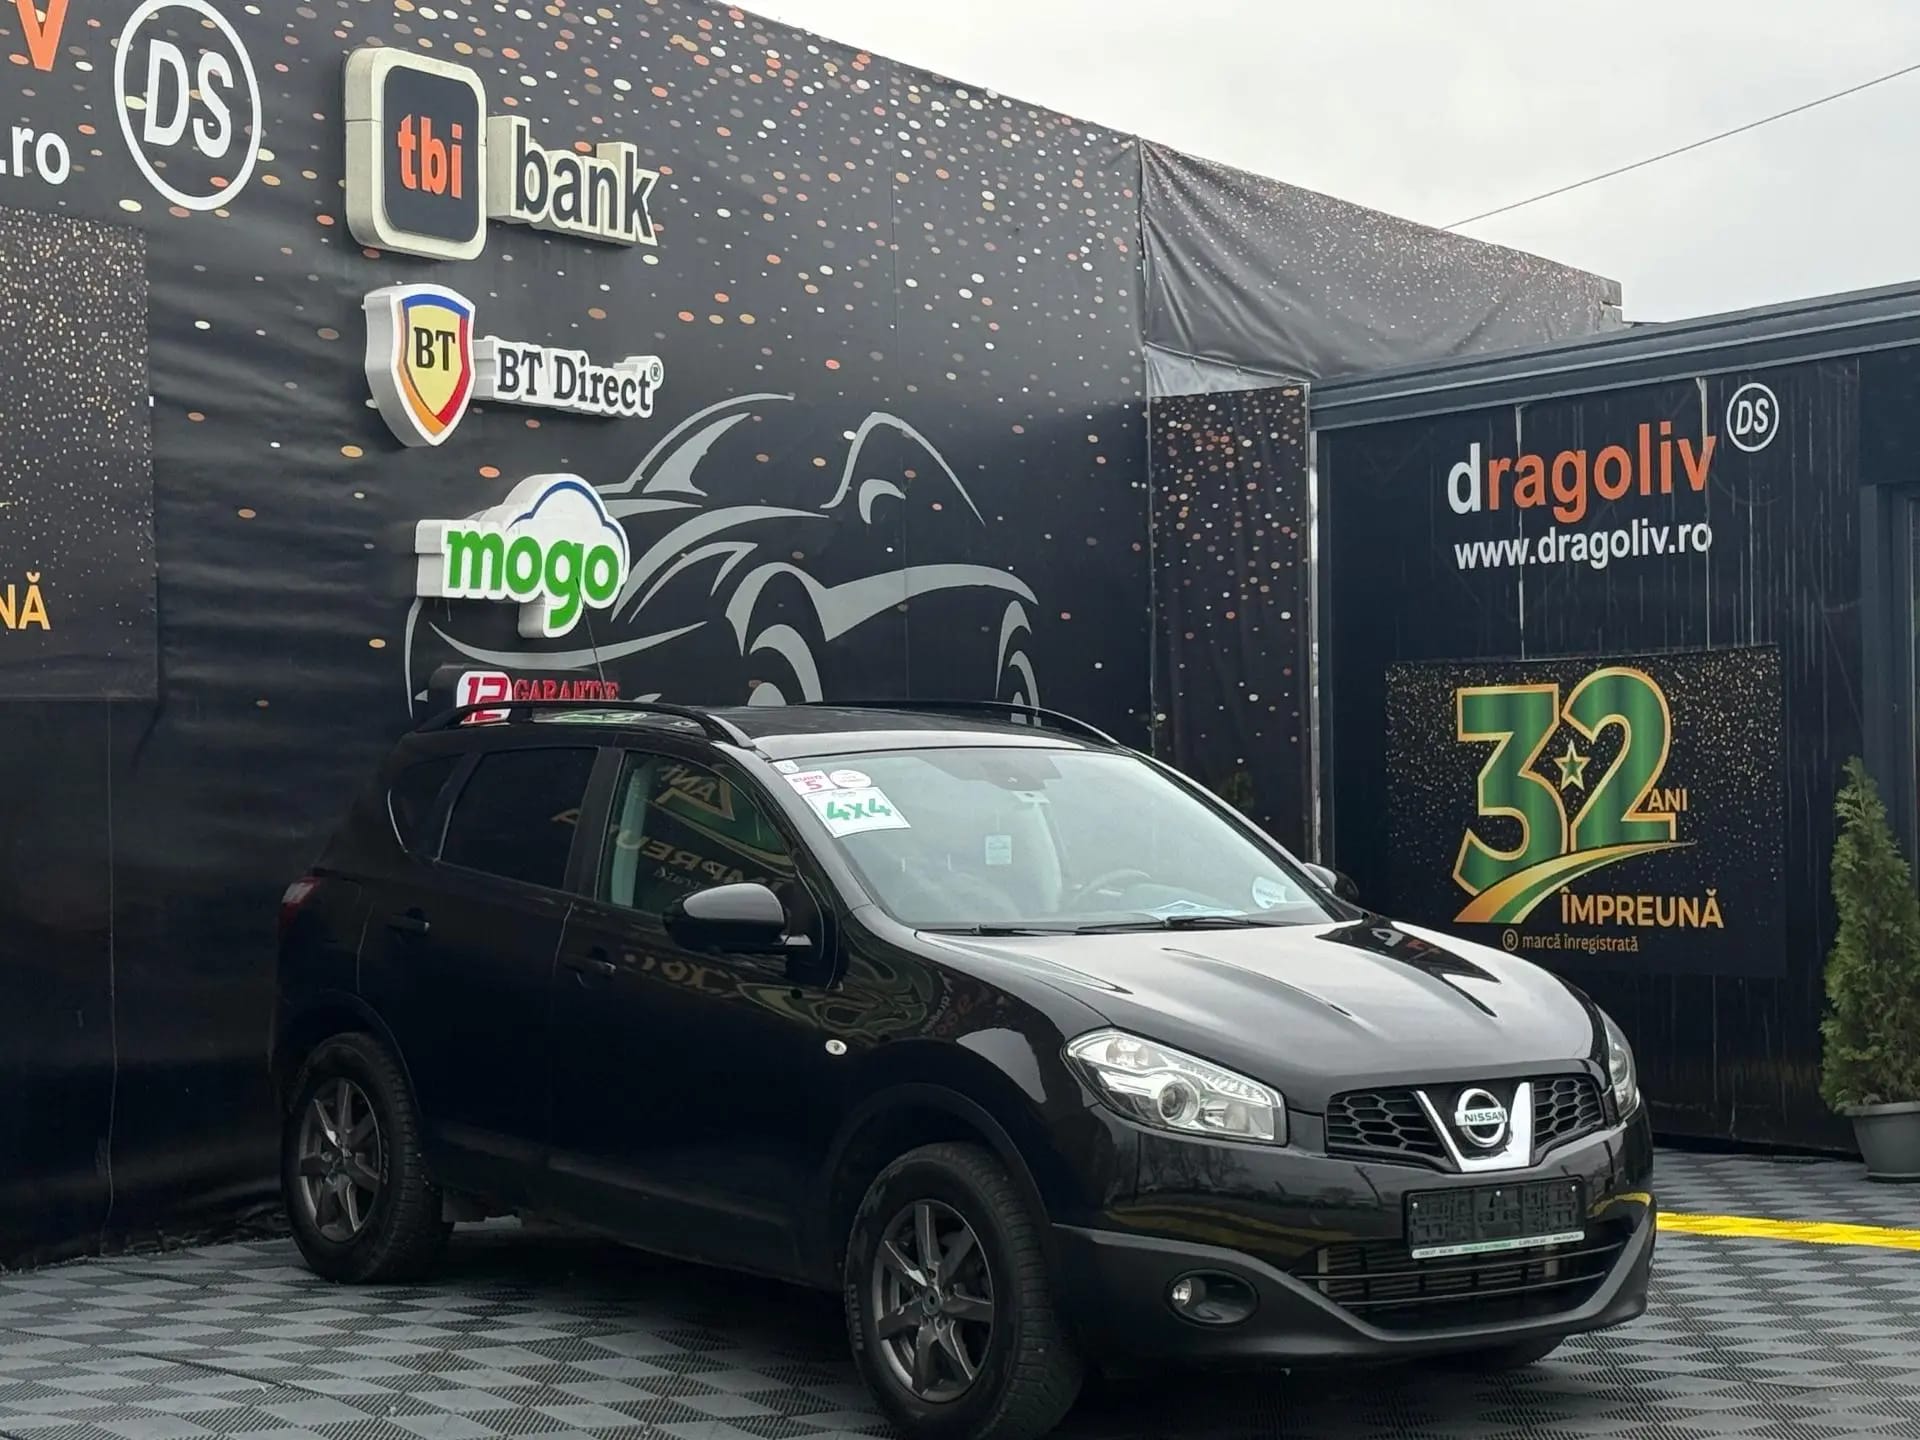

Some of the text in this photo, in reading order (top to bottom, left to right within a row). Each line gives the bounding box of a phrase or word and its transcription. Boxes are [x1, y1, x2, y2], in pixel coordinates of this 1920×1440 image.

[144, 39, 233, 158] DS
[398, 114, 654, 239] tbi bank
[414, 326, 455, 372] BT
[497, 347, 543, 396] BT
[1736, 398, 1769, 435] DS
[1447, 421, 1716, 523] dragoliv
[1454, 518, 1712, 570] www.dragoliv.ro
[447, 529, 620, 629] mogo
[805, 780, 823, 790] 5
[1452, 667, 1675, 897] 32
[1647, 788, 1688, 812] ANI
[1561, 887, 1724, 929] ÎMPREUNĂ
[1522, 934, 1561, 950] marcă
[1564, 933, 1639, 955] înregistrată
[1464, 1111, 1505, 1122] NISSAN
